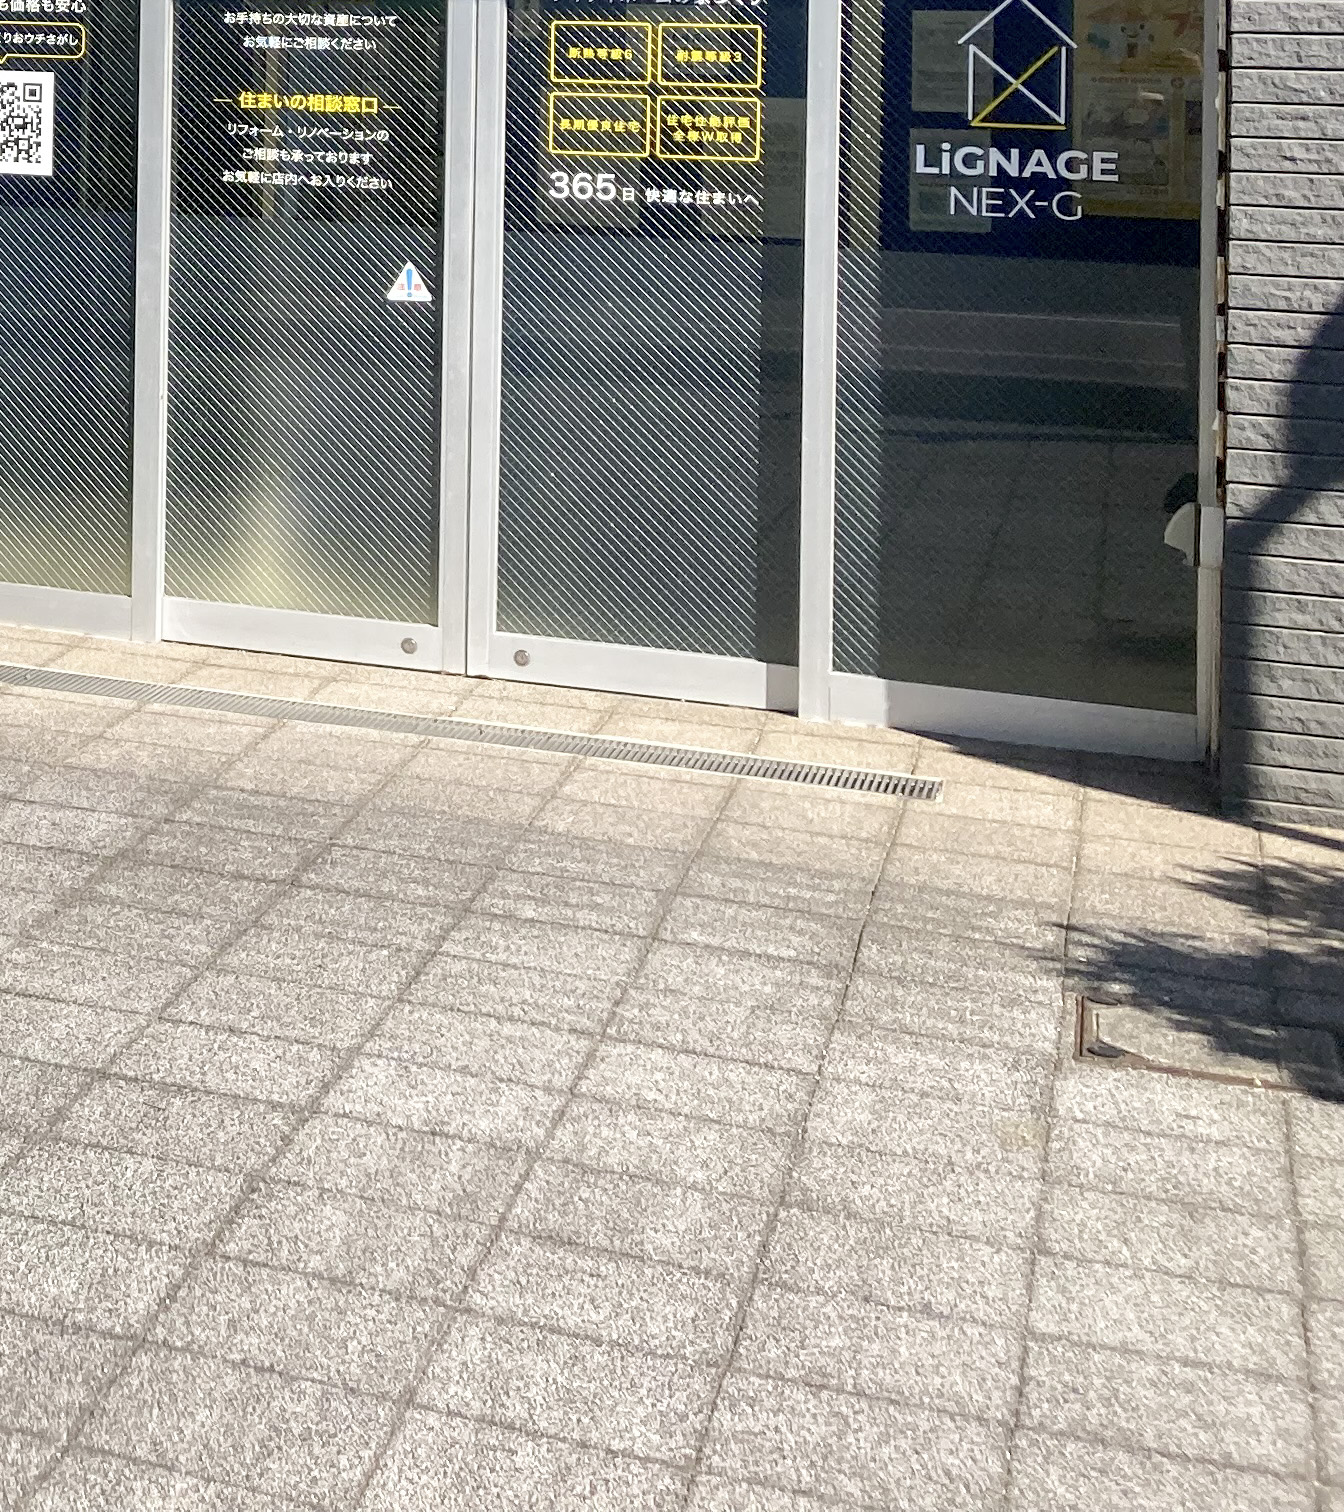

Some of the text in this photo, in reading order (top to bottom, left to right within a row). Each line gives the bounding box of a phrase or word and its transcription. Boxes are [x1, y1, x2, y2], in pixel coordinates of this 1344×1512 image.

[223, 12, 398, 28] お手持ちの大切な資産について
[242, 36, 377, 51] お気軽にご相談ください
[238, 91, 379, 114] 住まいの相談窓口
[559, 118, 641, 133] 長期優良住宅
[666, 114, 751, 129] 住宅性能評価
[226, 123, 390, 142] リフォーム・リノベーションの
[242, 148, 373, 165] ご相談も承っております
[915, 142, 1120, 183] LiGNAGE
[222, 169, 393, 189] お気軽に店内へお入りください
[644, 187, 760, 207] 快適な住まいへ
[949, 185, 1084, 221] NEX-G
